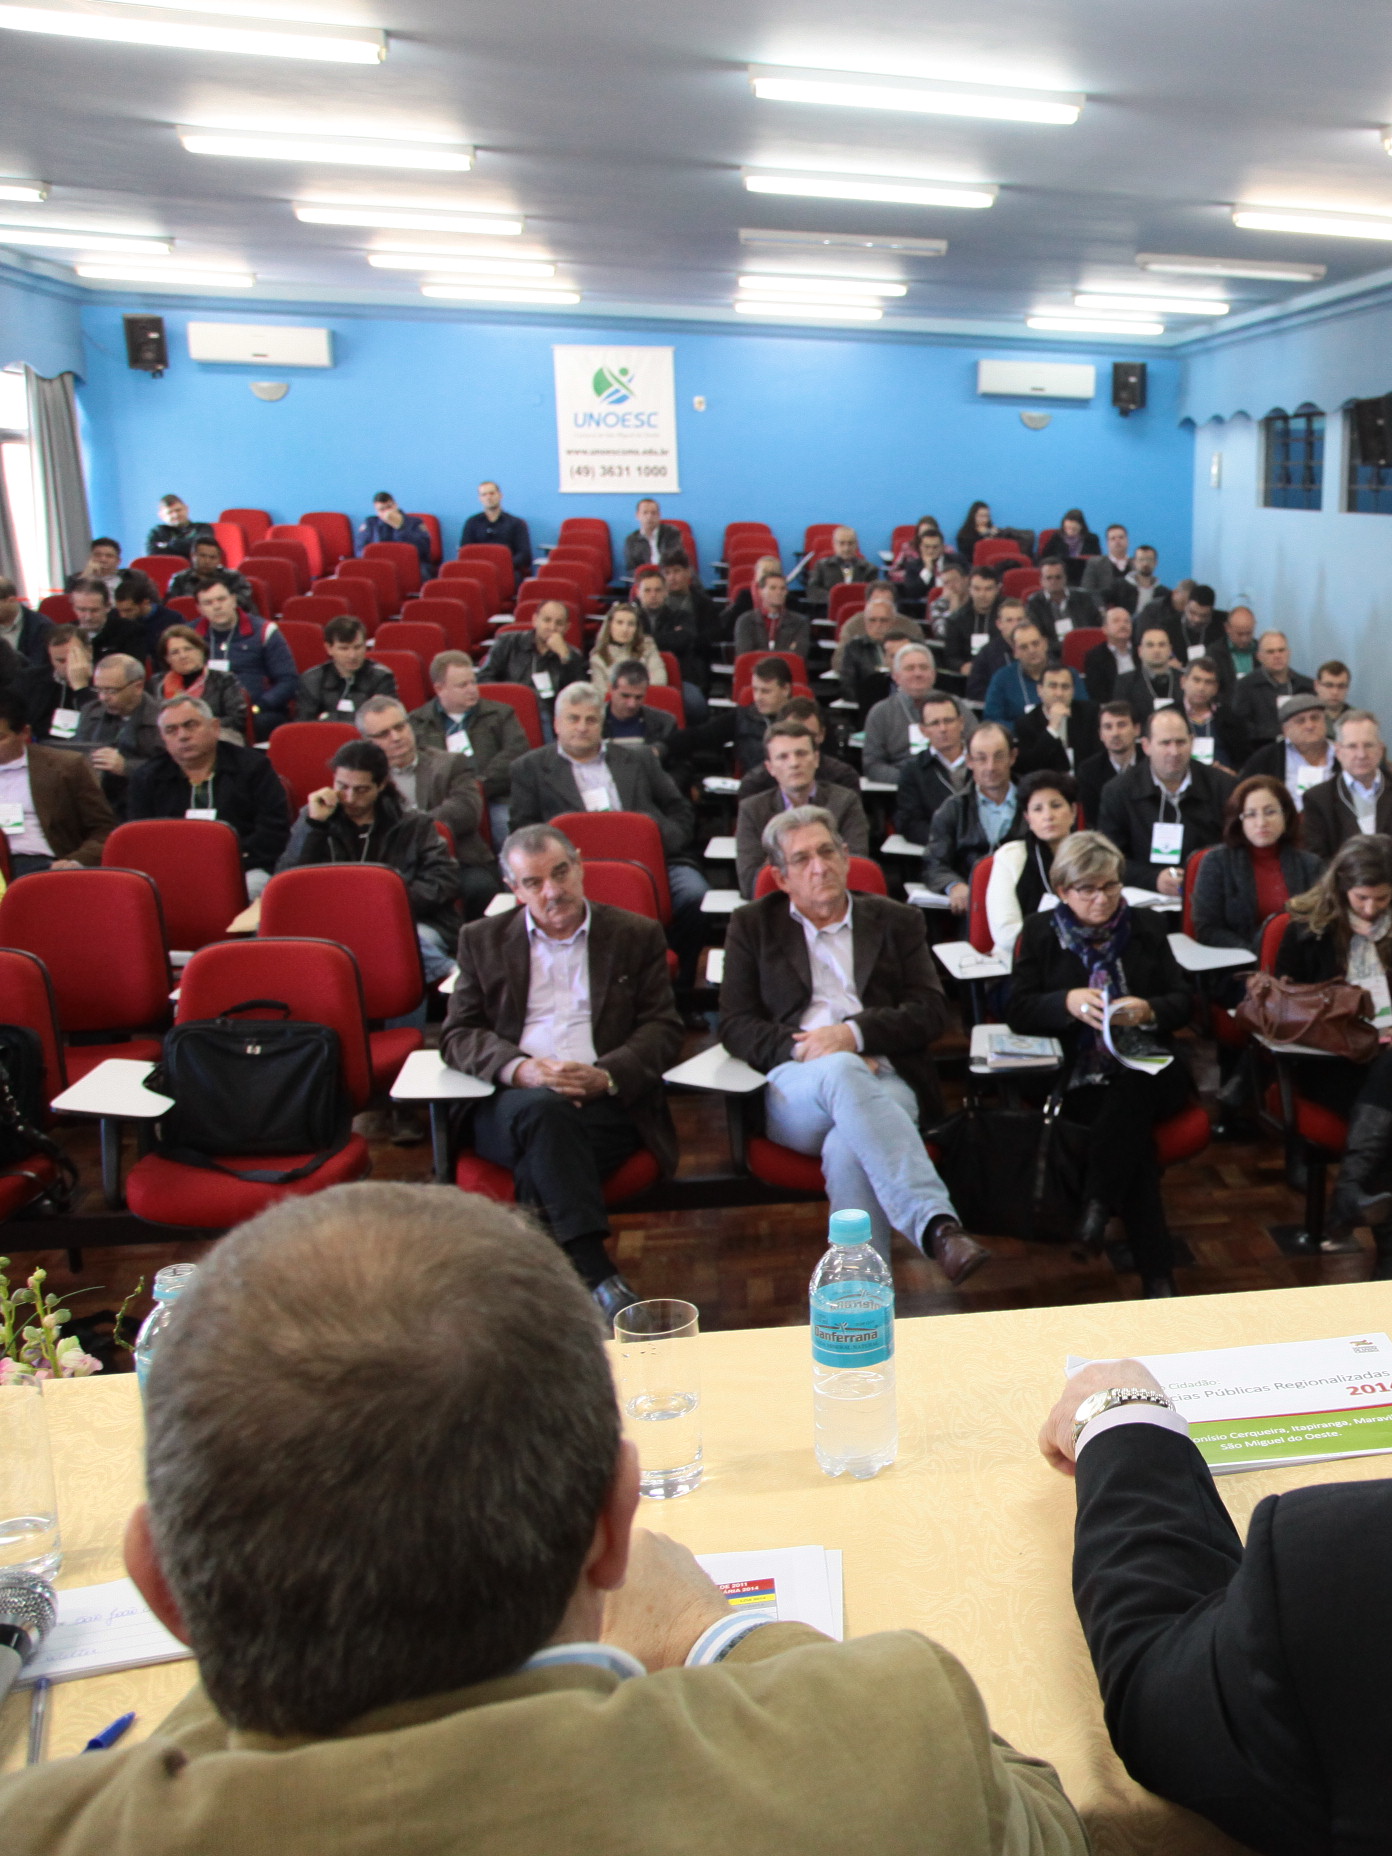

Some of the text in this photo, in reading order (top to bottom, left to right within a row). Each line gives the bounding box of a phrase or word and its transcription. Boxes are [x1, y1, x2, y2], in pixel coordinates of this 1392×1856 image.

[574, 411, 658, 429] UNOESC
[569, 465, 668, 481] (49) 3631 1000
[814, 1326, 878, 1343] Danferrana
[1170, 1369, 1391, 1402] cias Públicas Regionalizadas
[1192, 1434, 1227, 1444] onísio
[1229, 1427, 1290, 1440] Cerqueira,
[1291, 1417, 1352, 1432] Itapiranga,
[1220, 1430, 1342, 1451] São Miguel do Oeste.
